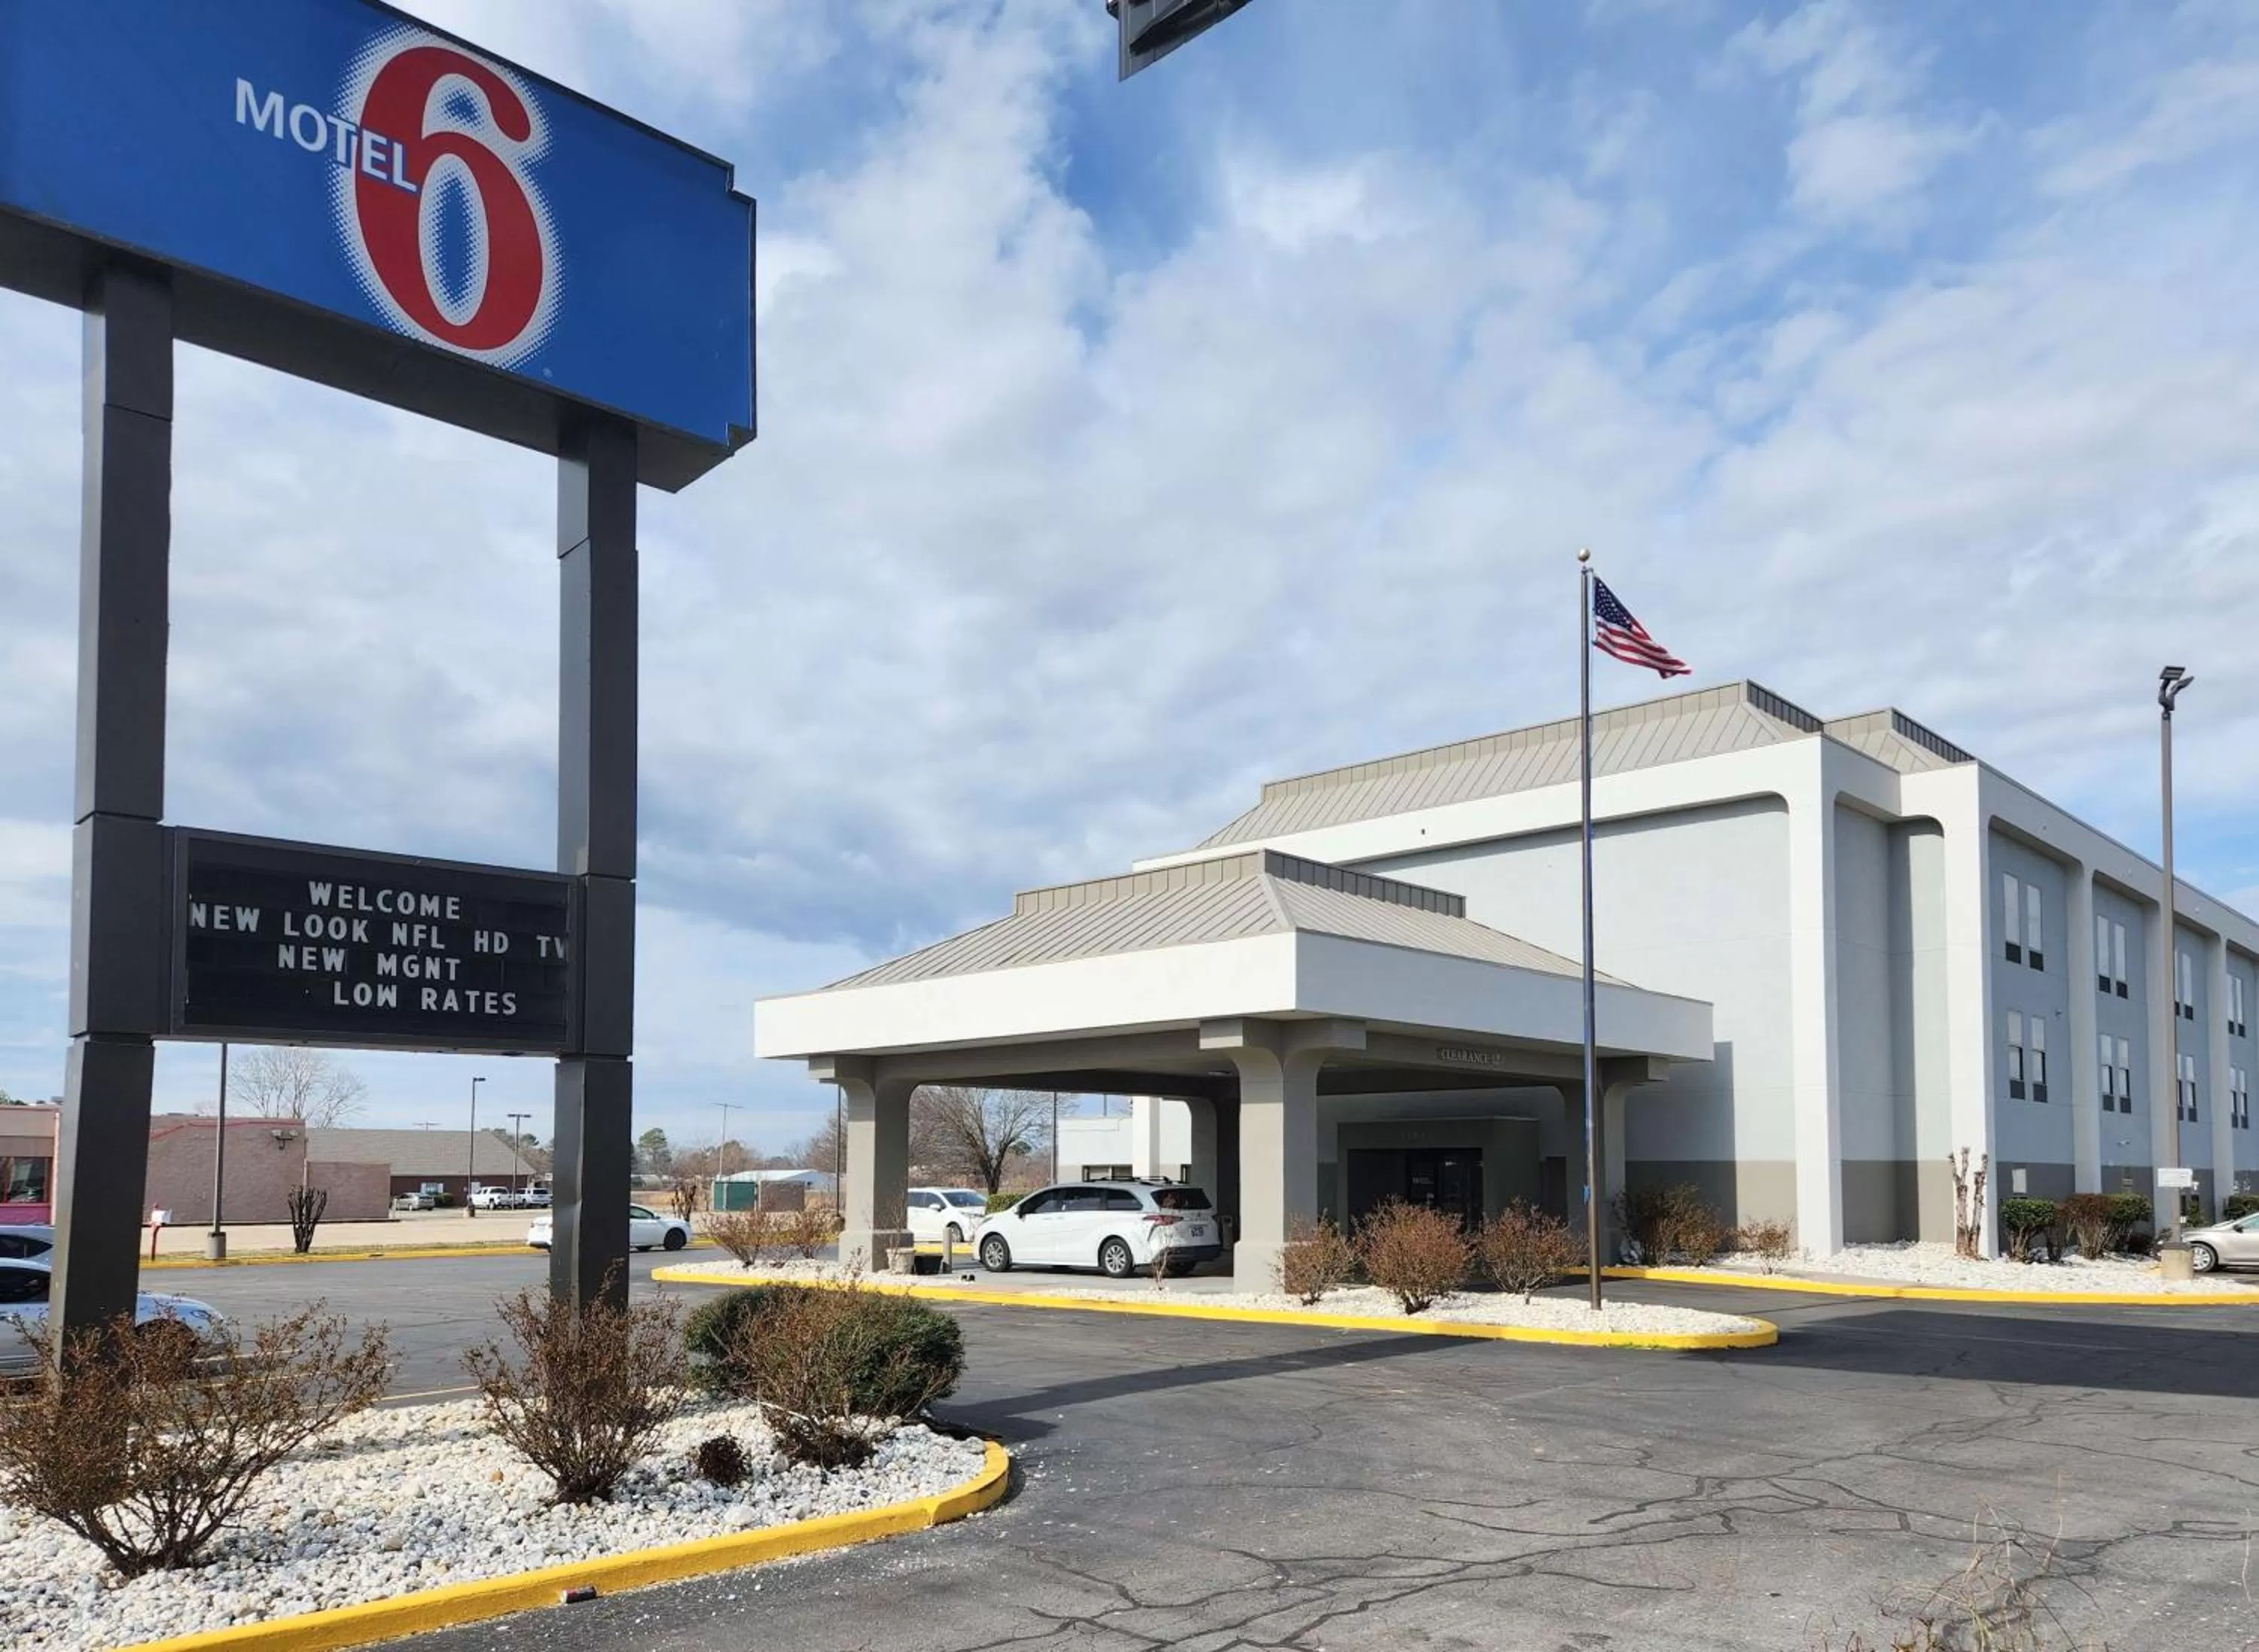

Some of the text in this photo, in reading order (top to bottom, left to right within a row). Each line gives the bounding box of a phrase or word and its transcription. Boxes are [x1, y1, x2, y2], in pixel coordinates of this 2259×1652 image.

[235, 77, 417, 192] MOTEL
[354, 46, 544, 352] 6
[309, 880, 461, 919] WELCOME
[190, 903, 259, 932] NEW
[283, 911, 369, 943] LOOK
[392, 922, 446, 949] NFL
[474, 930, 509, 954] HD
[278, 944, 461, 981] NEW MGNT
[334, 981, 517, 1016] LOW RATES
